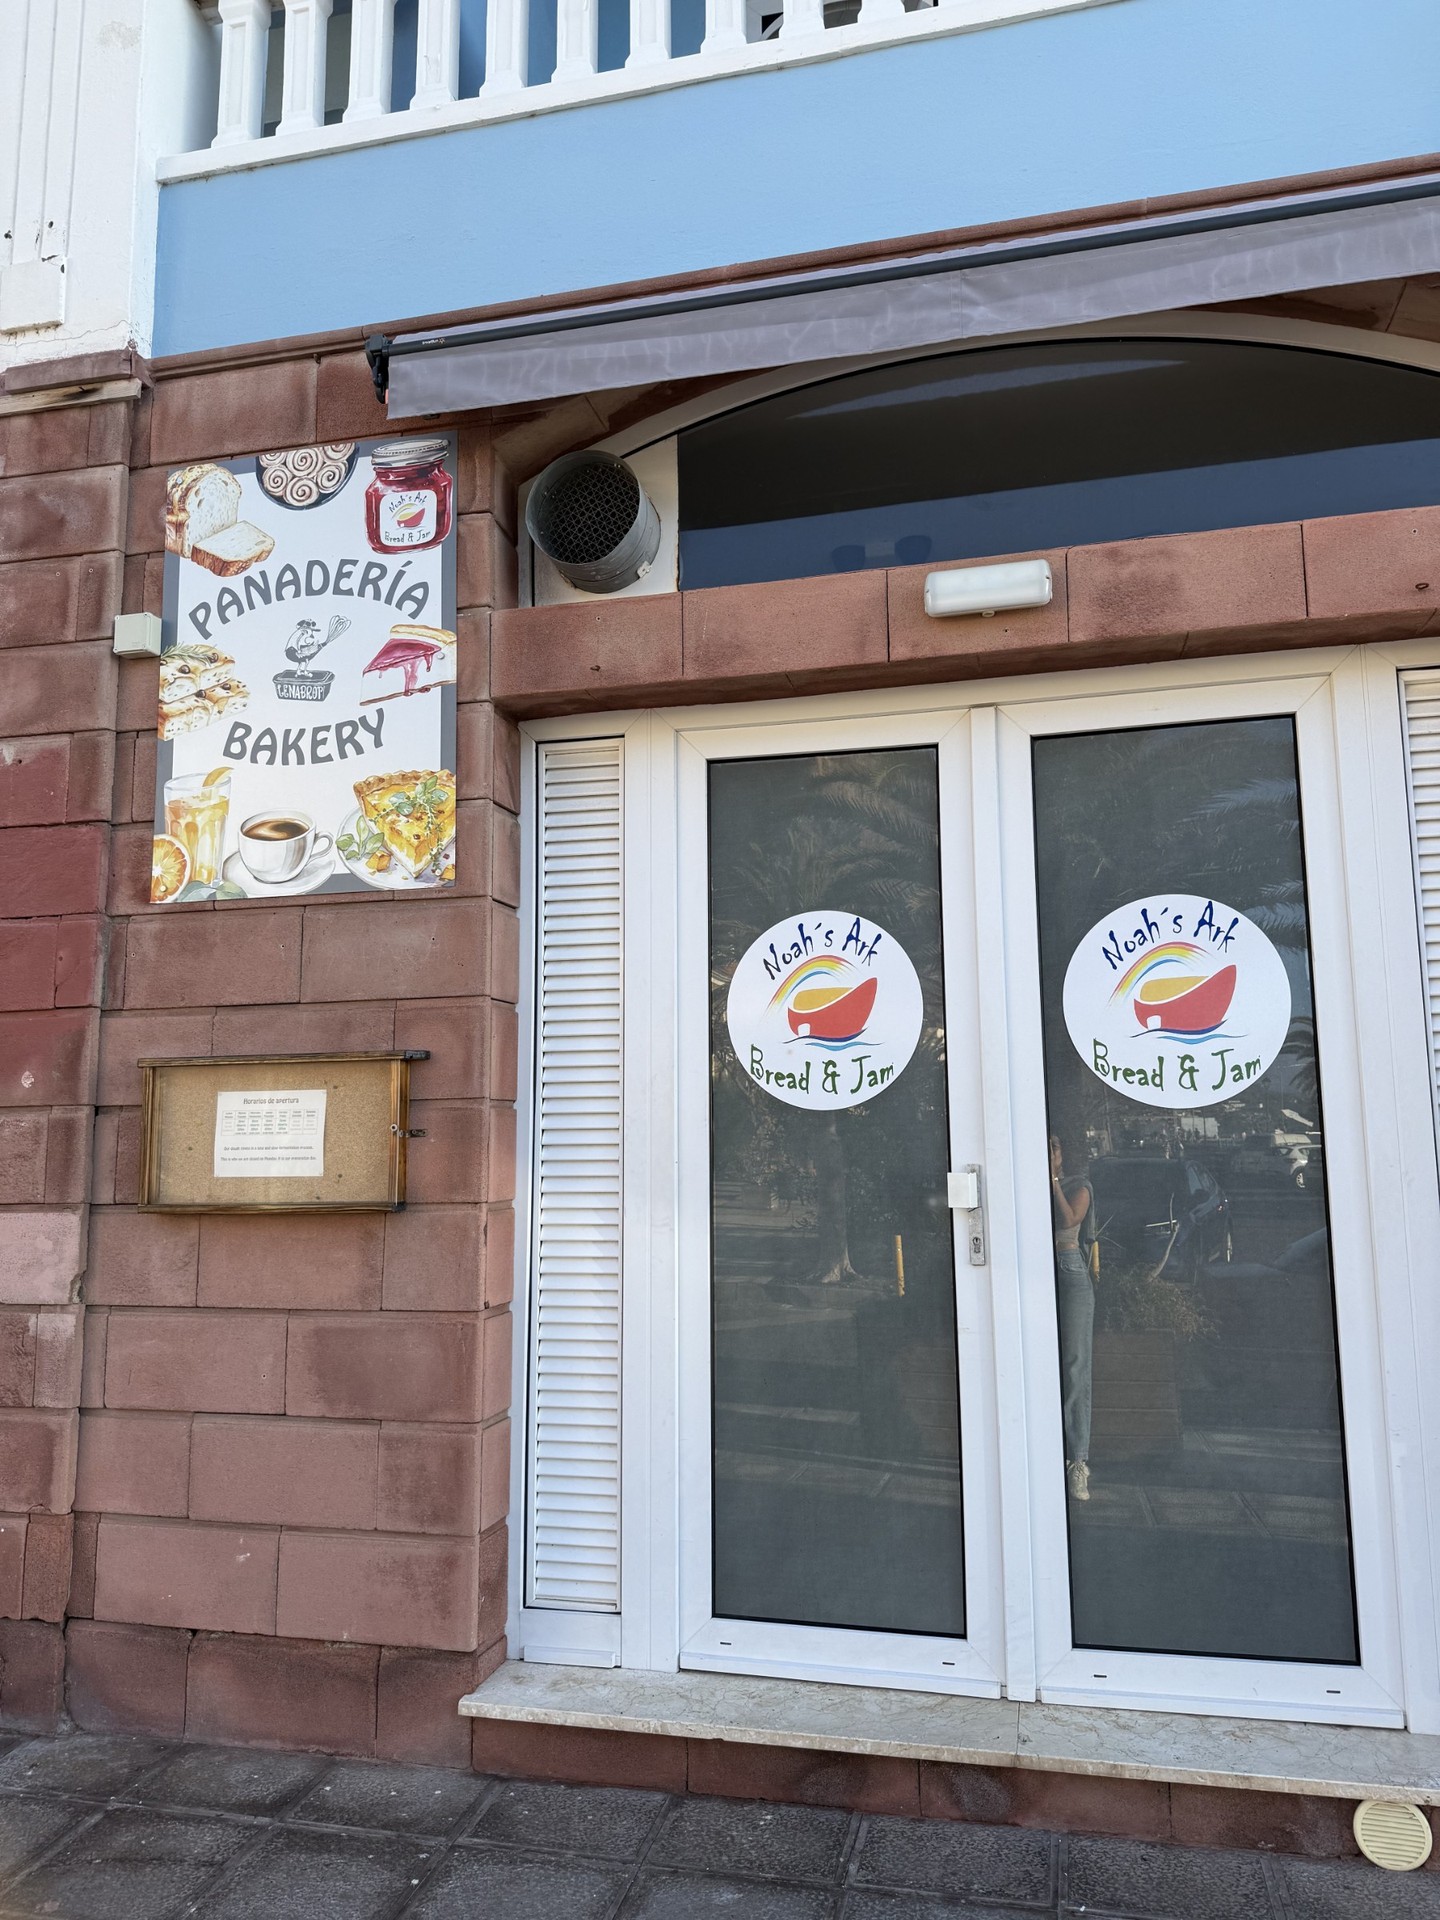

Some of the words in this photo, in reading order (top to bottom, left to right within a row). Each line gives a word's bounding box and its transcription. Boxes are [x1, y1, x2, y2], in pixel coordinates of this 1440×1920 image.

[384, 531, 404, 543] Bread
[188, 558, 430, 641] PANADERÍA
[223, 707, 385, 766] BAKERY
[841, 916, 882, 967] Ark
[1193, 900, 1239, 953] Ark
[750, 1043, 811, 1095] Bread
[821, 1059, 841, 1095] &
[850, 1054, 895, 1095] Jam
[1093, 1038, 1165, 1092] Bread
[1176, 1053, 1200, 1092] &
[1211, 1048, 1262, 1091] Jam
